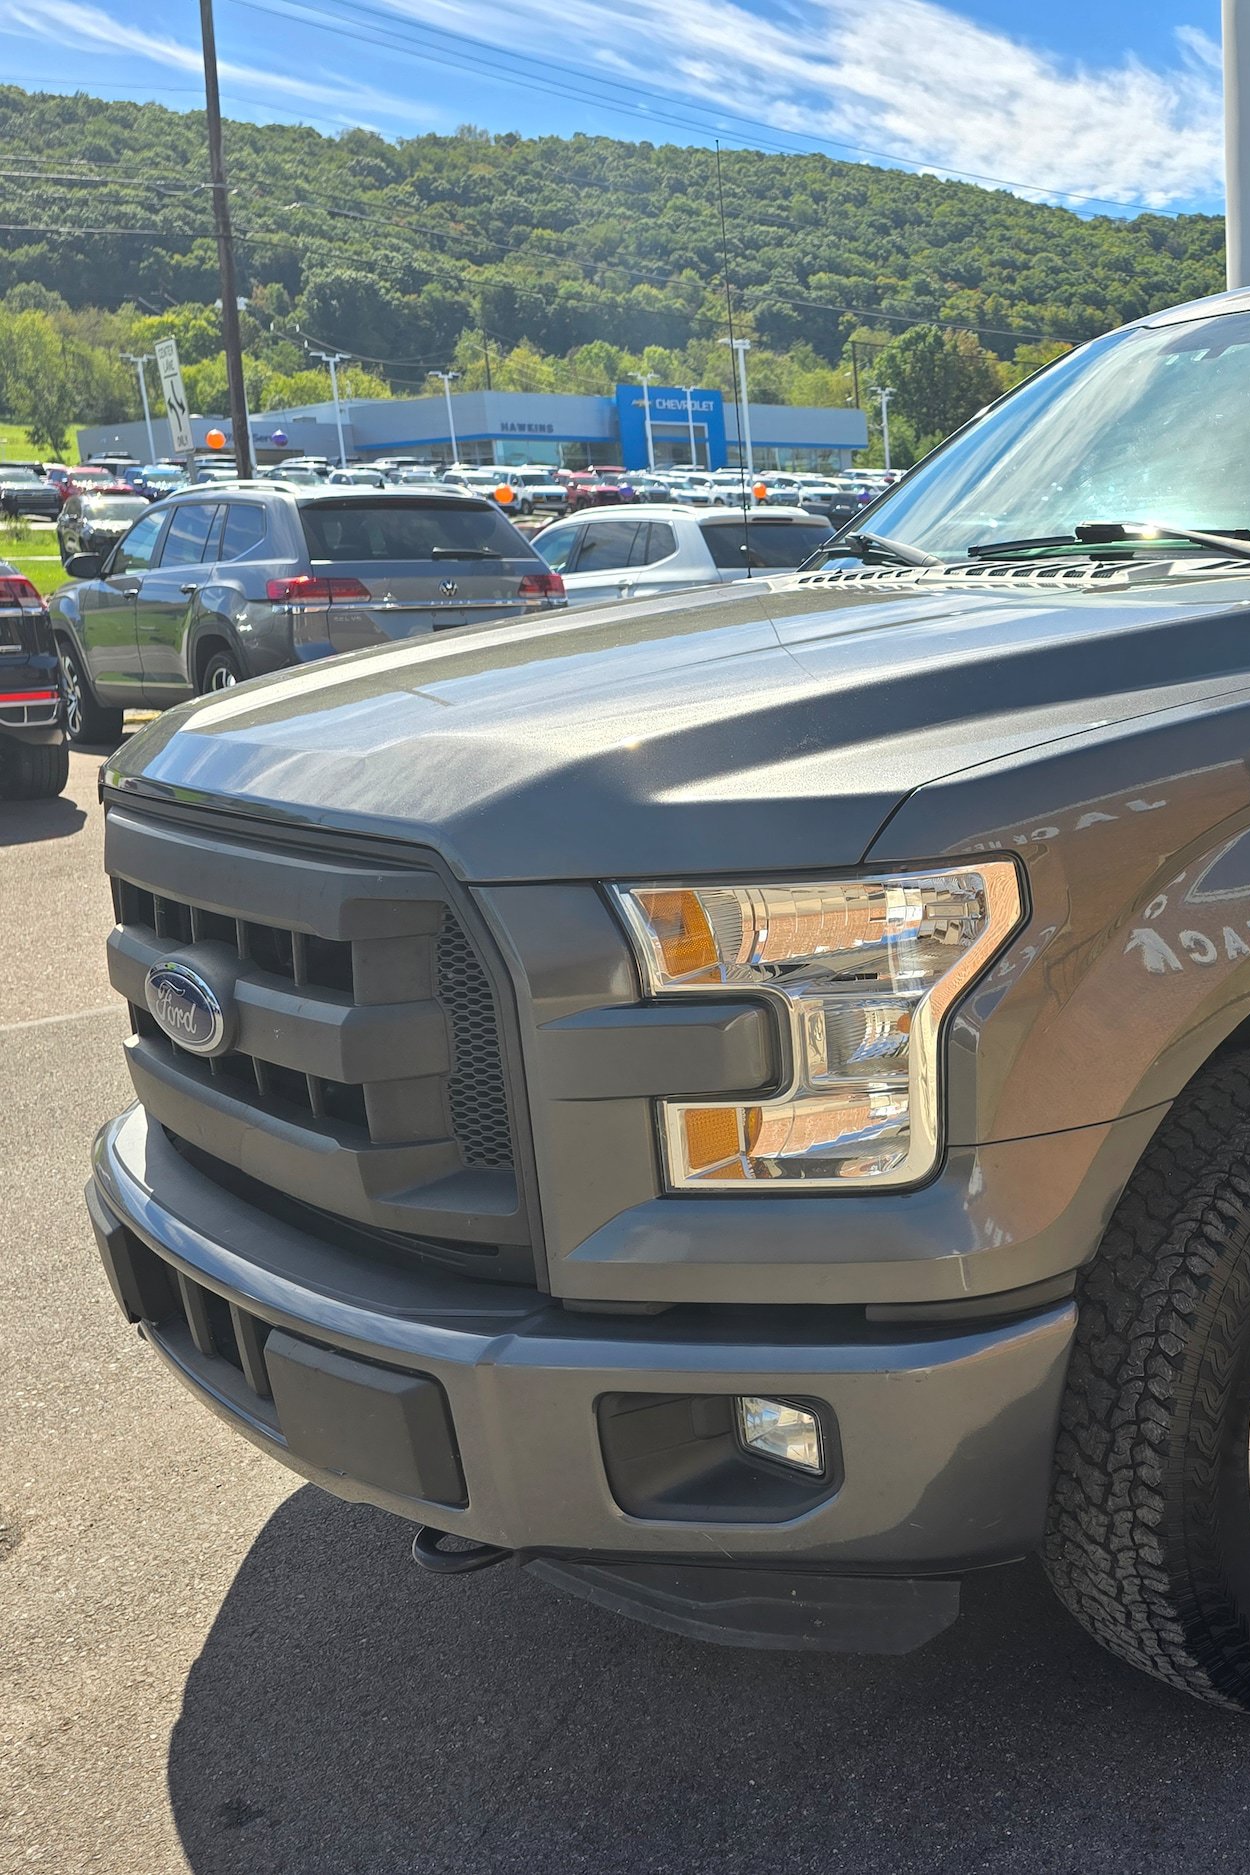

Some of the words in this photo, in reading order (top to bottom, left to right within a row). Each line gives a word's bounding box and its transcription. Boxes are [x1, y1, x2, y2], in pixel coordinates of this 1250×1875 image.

[163, 359, 176, 374] LANE
[655, 398, 715, 412] CHEVROLET
[500, 422, 554, 434] HAWKINS
[177, 435, 189, 447] ONLY
[156, 980, 197, 1034] Ford
